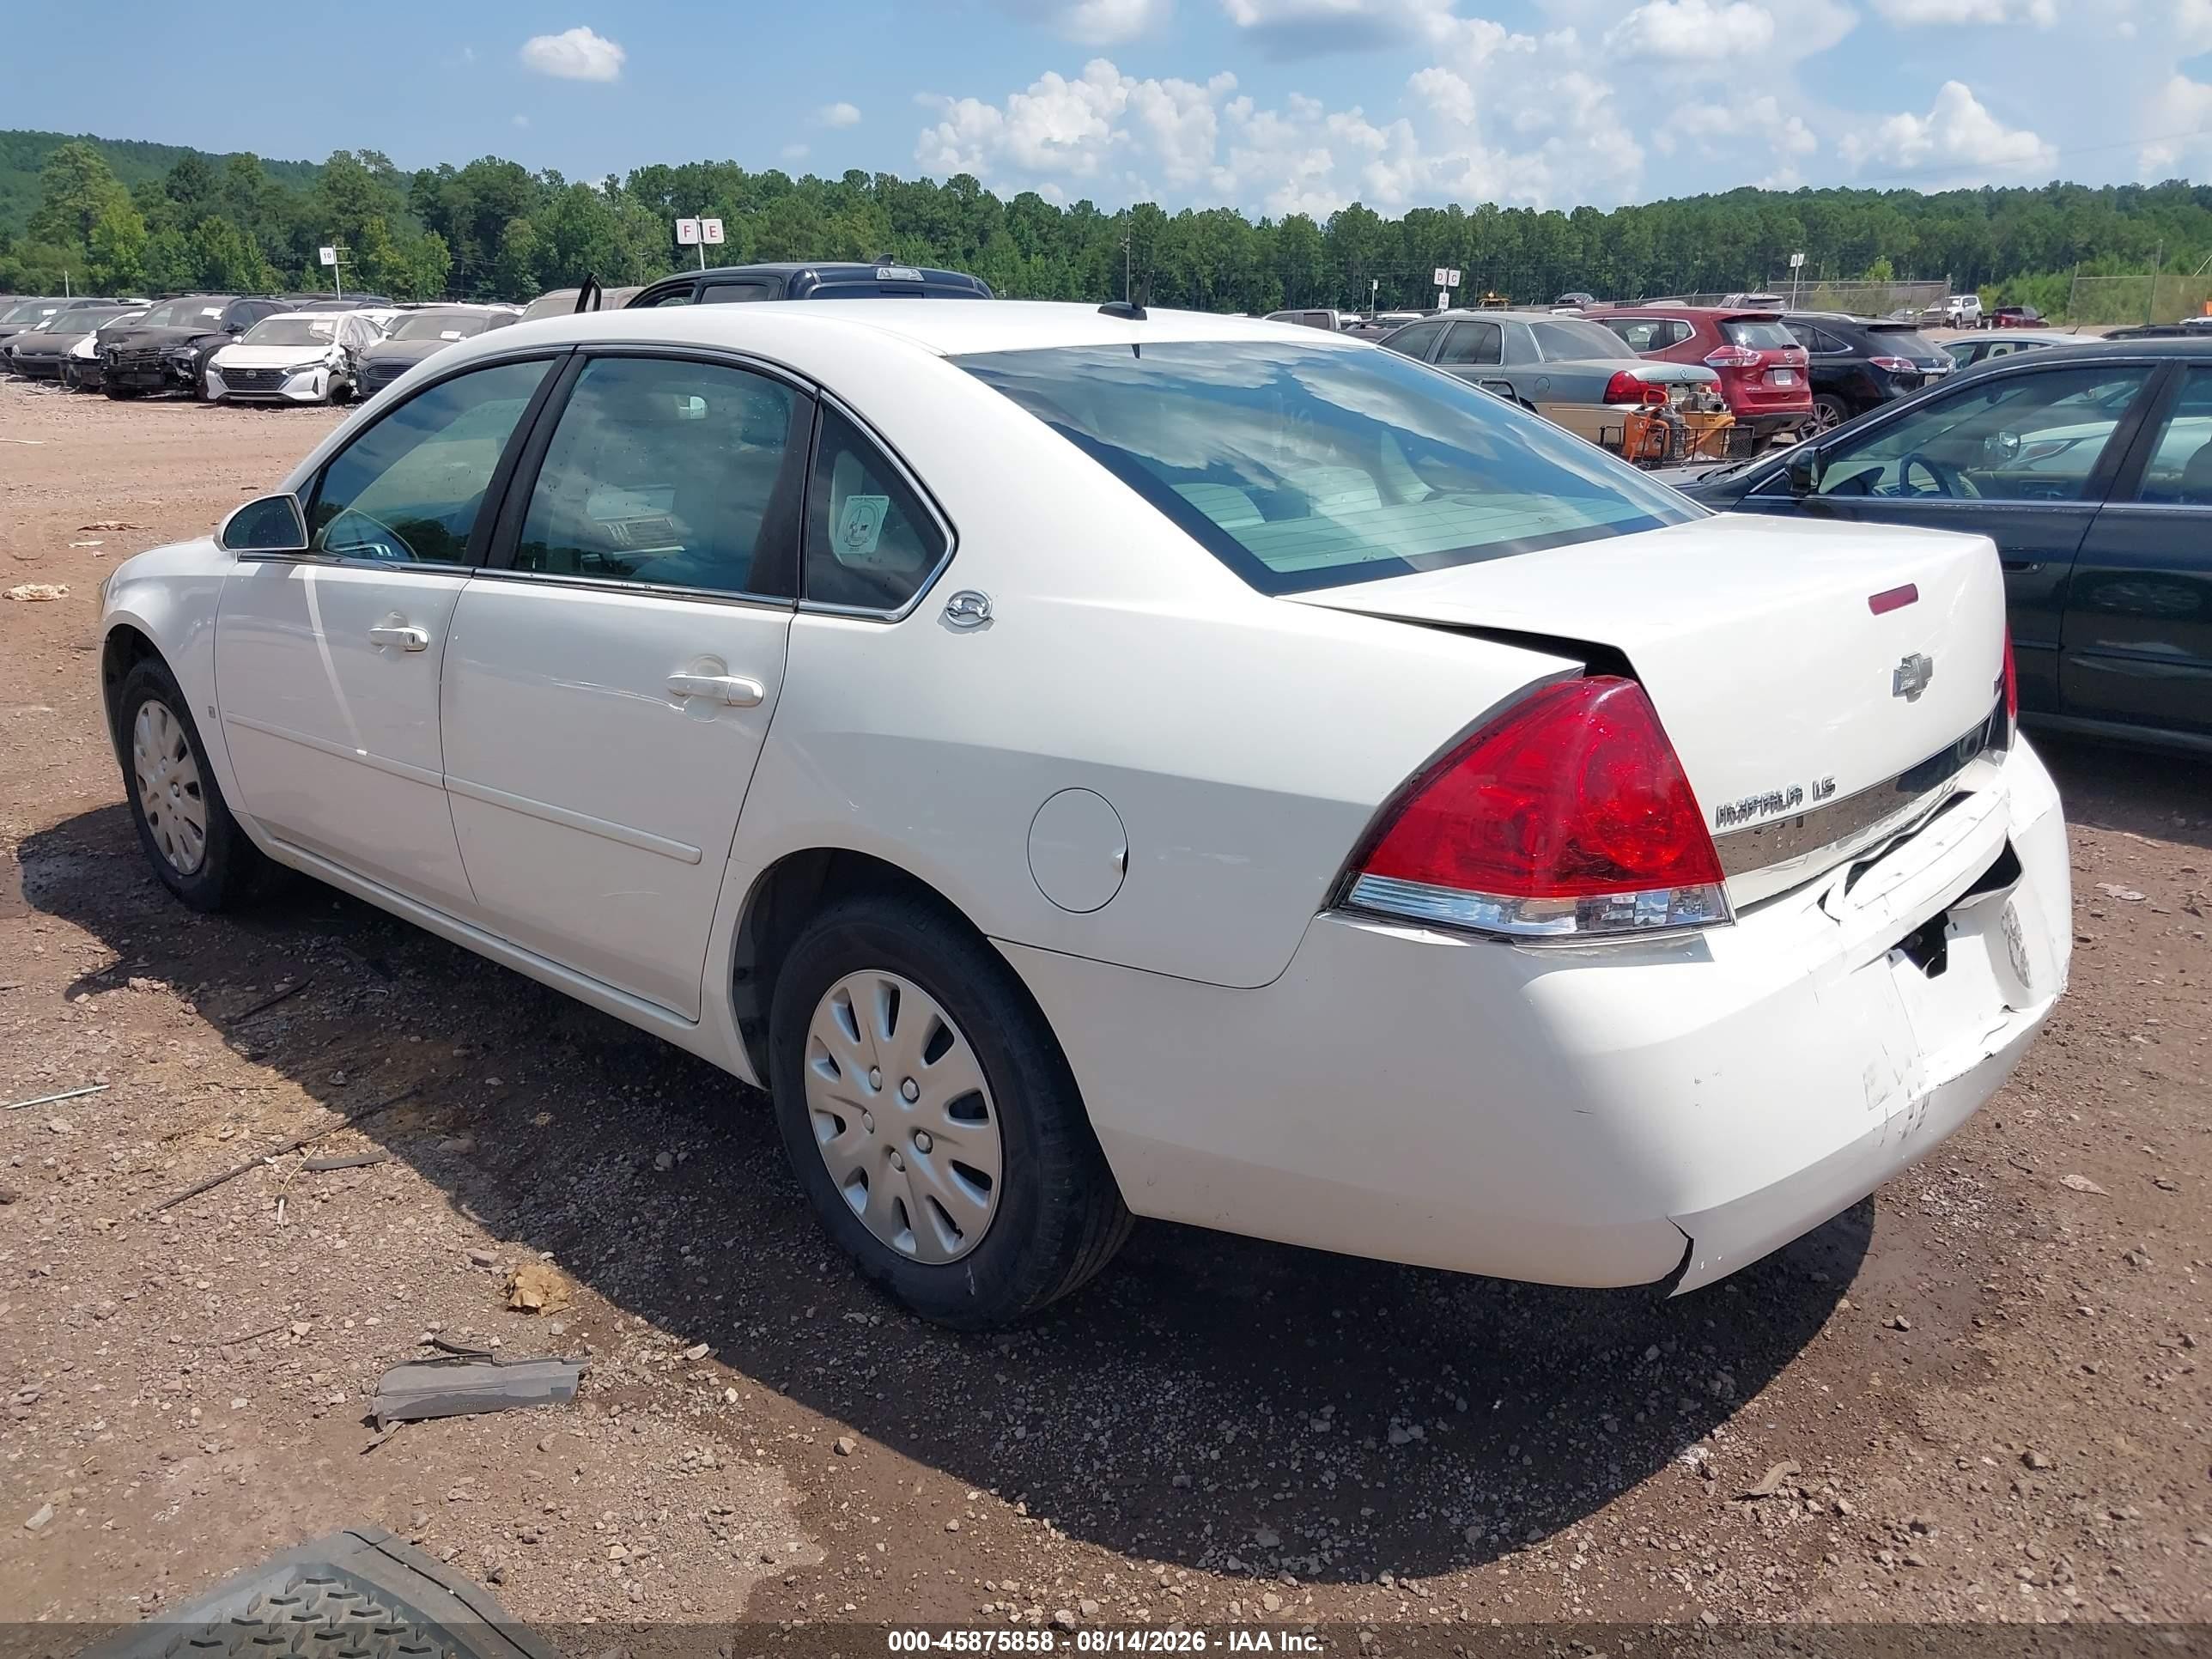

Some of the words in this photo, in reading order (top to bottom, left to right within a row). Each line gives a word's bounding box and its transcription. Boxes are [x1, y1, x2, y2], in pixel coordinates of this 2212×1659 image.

[683, 225, 691, 238] F
[708, 225, 718, 238] E
[1437, 272, 1443, 282] D
[1451, 274, 1457, 283] C
